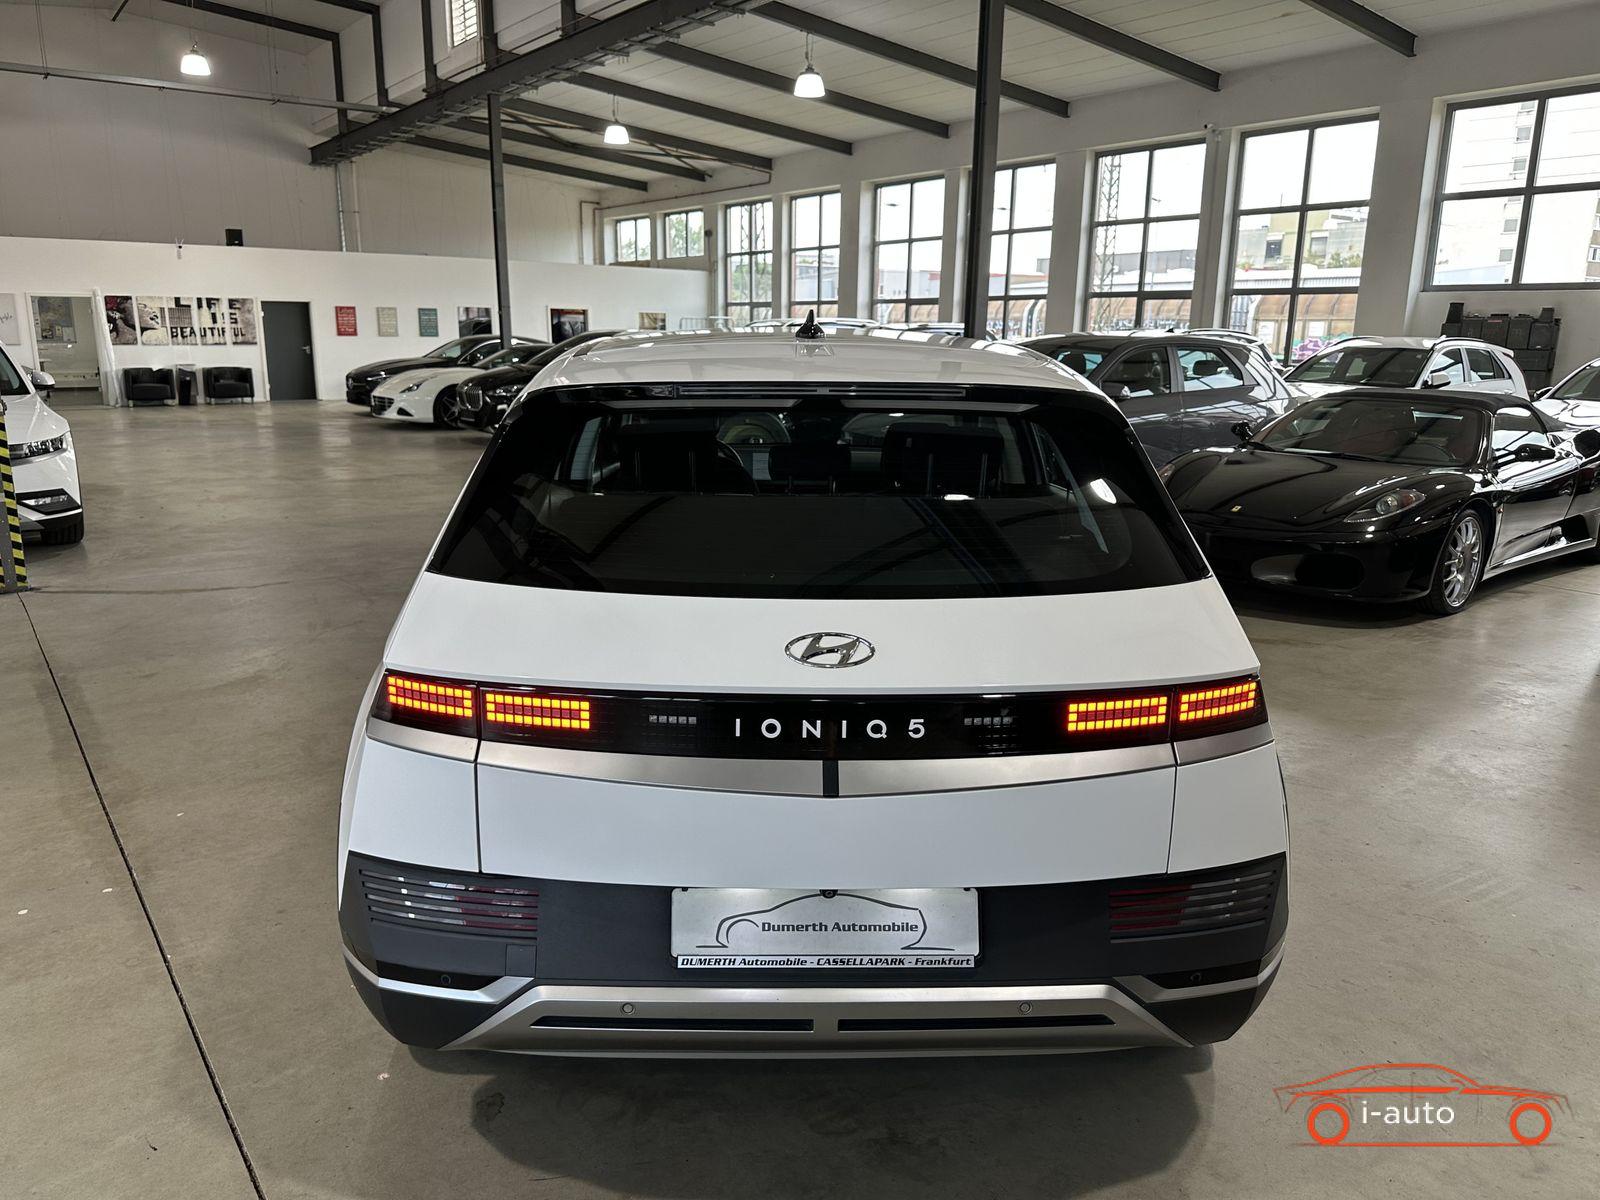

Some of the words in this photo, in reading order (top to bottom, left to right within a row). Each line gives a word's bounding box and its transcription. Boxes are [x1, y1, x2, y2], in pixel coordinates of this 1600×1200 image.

[174, 296, 241, 309] LIFE
[170, 326, 246, 339] BEAUTIFUL
[735, 718, 888, 738] IONIQ
[907, 718, 926, 738] 5
[761, 922, 828, 932] Dumerth
[831, 922, 919, 932] Automobile
[681, 957, 737, 966] DUMERTH
[738, 957, 808, 966] Automobile
[816, 957, 906, 966] CASSELLAPARK
[914, 957, 972, 966] Frankfurt
